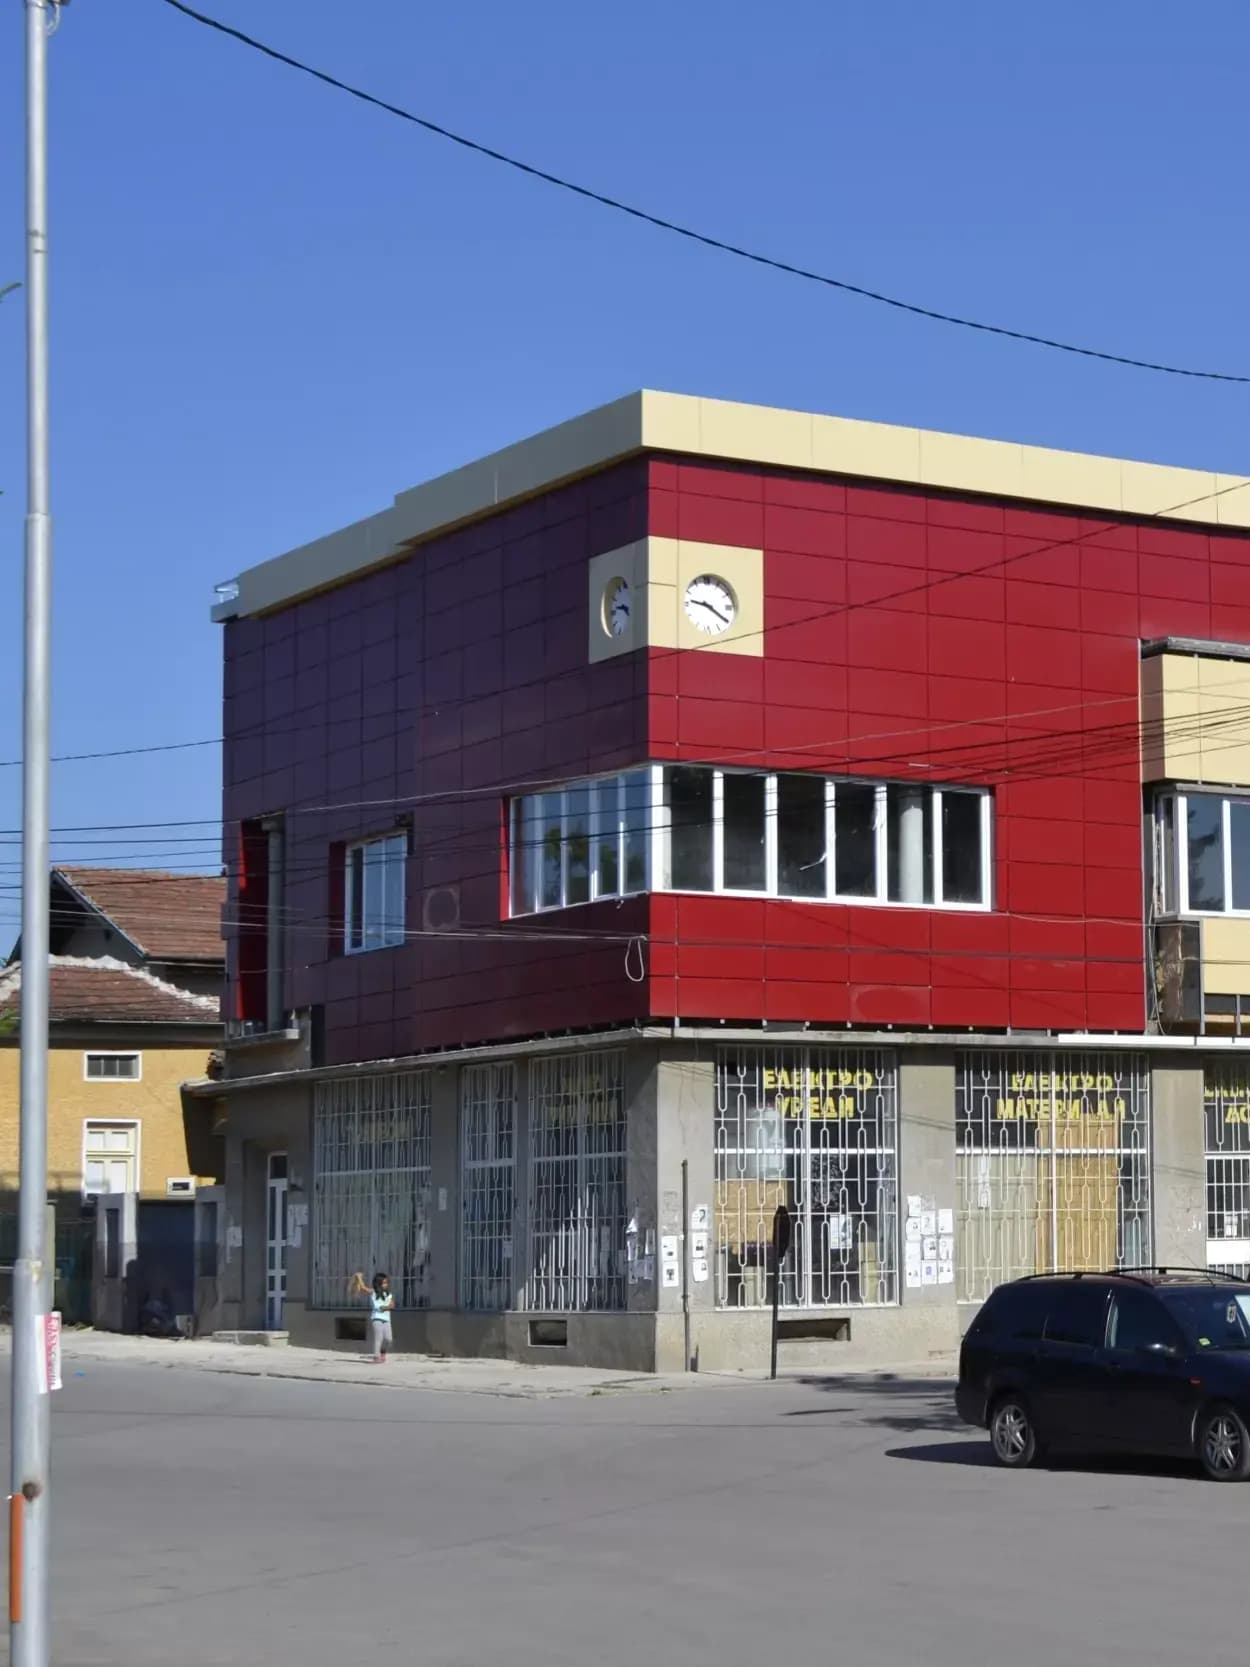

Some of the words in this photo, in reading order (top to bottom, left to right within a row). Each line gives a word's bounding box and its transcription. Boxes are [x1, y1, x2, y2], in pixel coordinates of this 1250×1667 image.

[763, 1069, 873, 1090] ЕЛЕКТРО
[1011, 1072, 1113, 1092] ЕЛЕКТРО
[776, 1096, 854, 1118] УРЕДИ
[996, 1098, 1126, 1120] МАТЕРИЛИ
